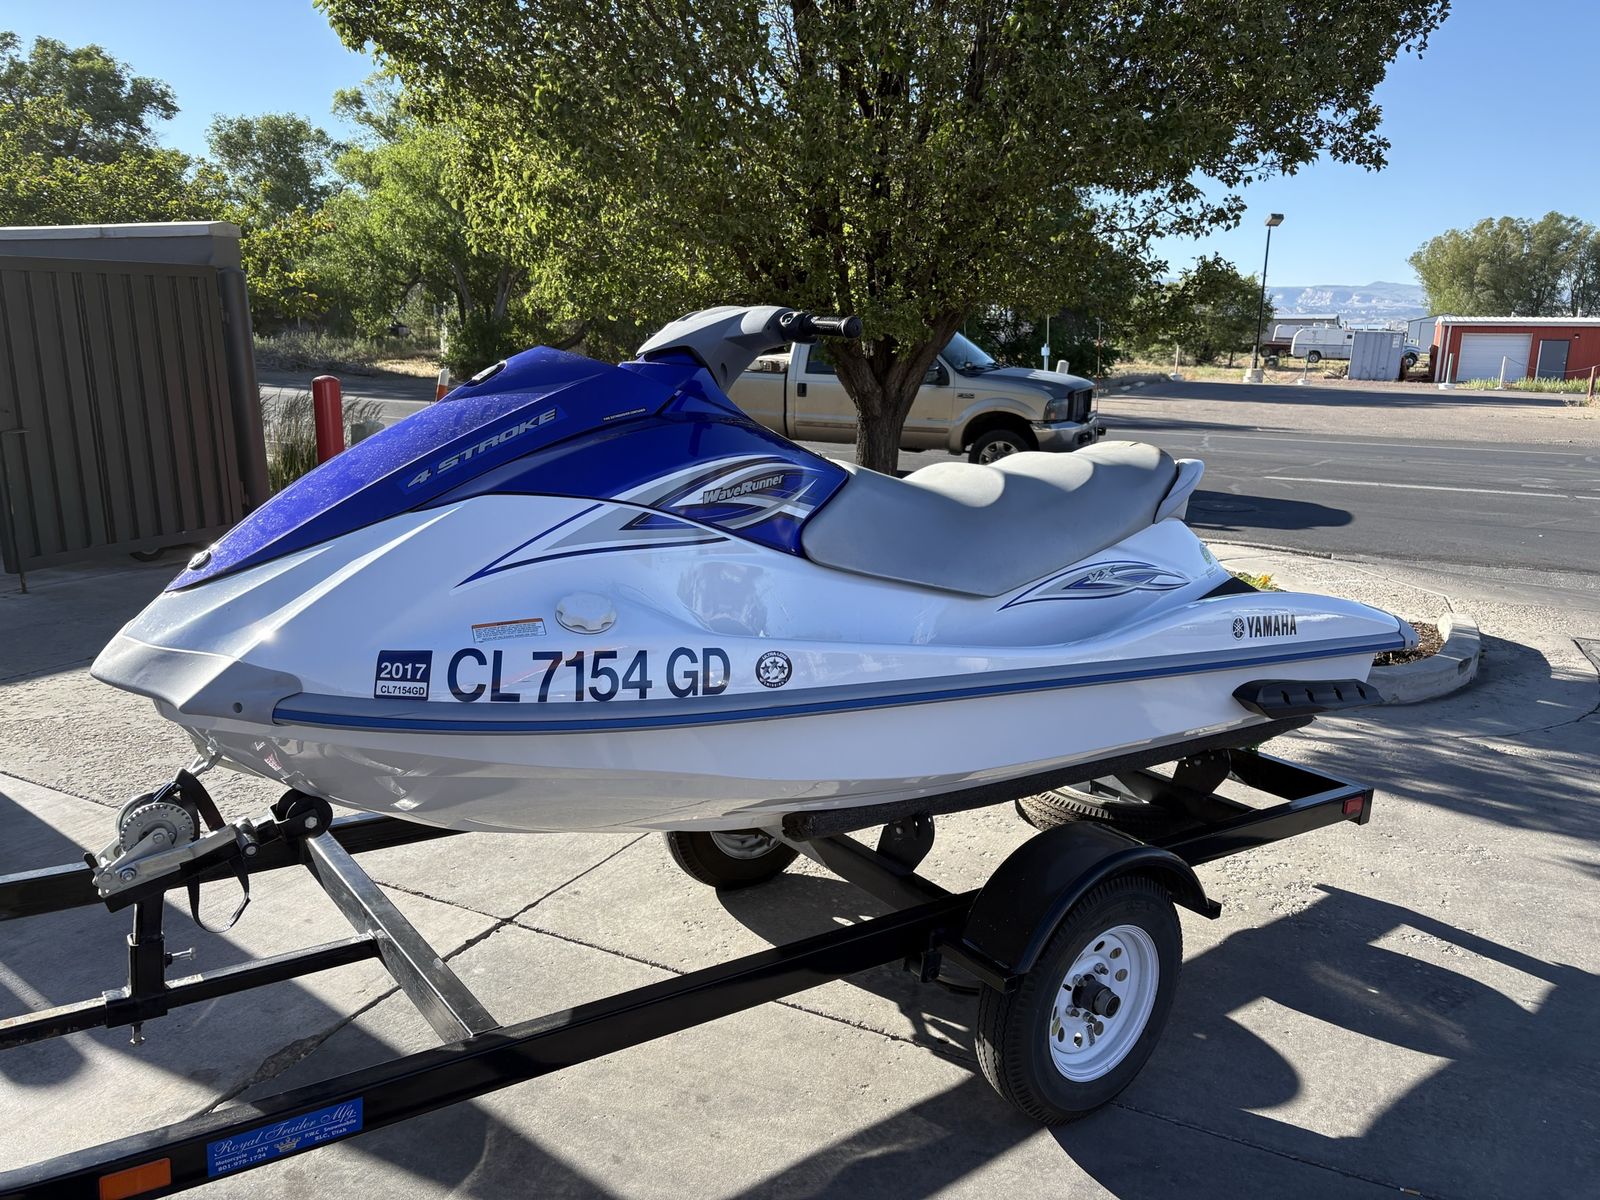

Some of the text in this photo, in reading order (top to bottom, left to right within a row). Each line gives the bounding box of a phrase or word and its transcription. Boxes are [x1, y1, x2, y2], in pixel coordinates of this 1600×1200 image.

[407, 408, 557, 488] 4 STROKE
[703, 474, 785, 504] WaveRunner
[1246, 614, 1297, 638] YAMAHA
[380, 662, 427, 679] 2017
[447, 647, 731, 702] CL 7154 GD
[380, 685, 425, 696] CL7154GD
[215, 1131, 263, 1154] Royal
[265, 1121, 316, 1140] Trailer
[215, 1153, 248, 1167] Motorcycle
[257, 1145, 269, 1153] ATV
[323, 1119, 357, 1132] Snowmobile
